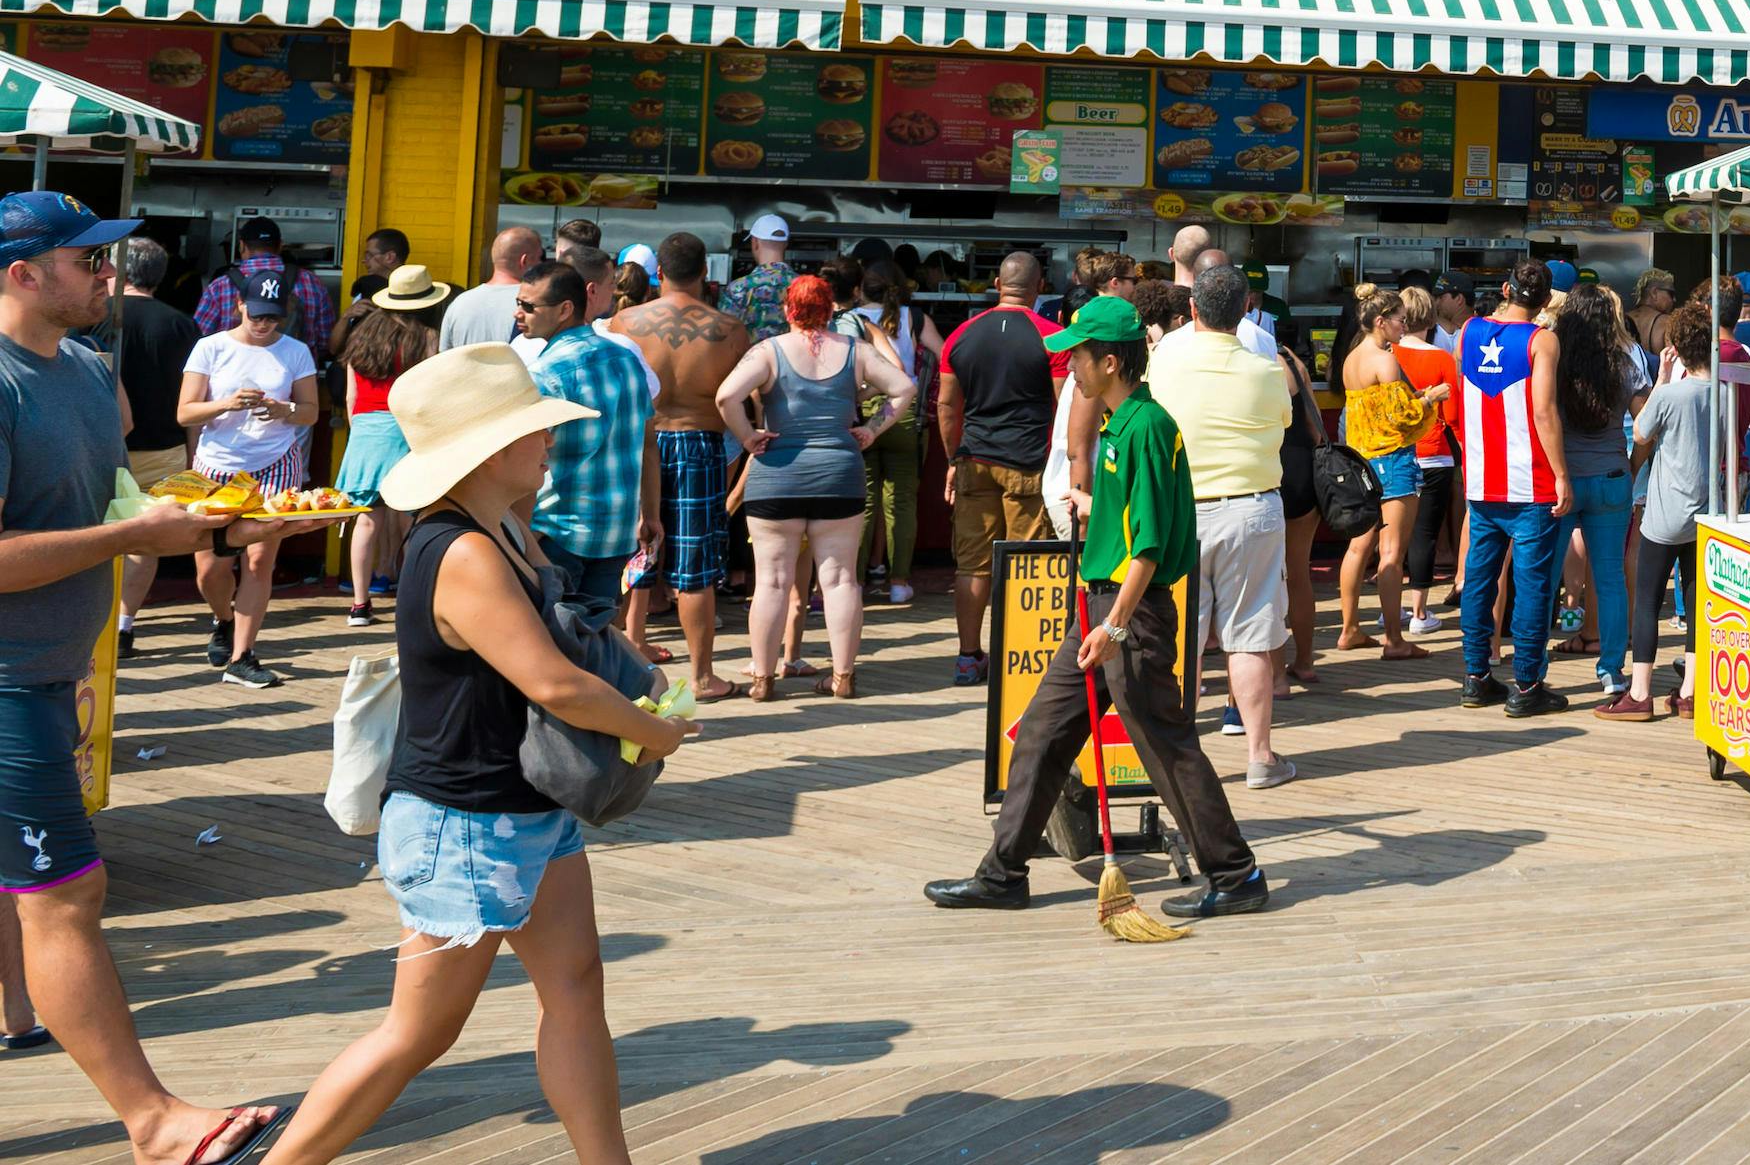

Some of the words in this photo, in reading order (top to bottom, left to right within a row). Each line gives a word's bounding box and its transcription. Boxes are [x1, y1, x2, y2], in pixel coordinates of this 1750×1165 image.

[1077, 105, 1117, 120] Beer
[1020, 586, 1045, 612] OF
[1711, 628, 1727, 646] FOR
[1728, 630, 1750, 649] OVER
[1008, 649, 1055, 675] PAST
